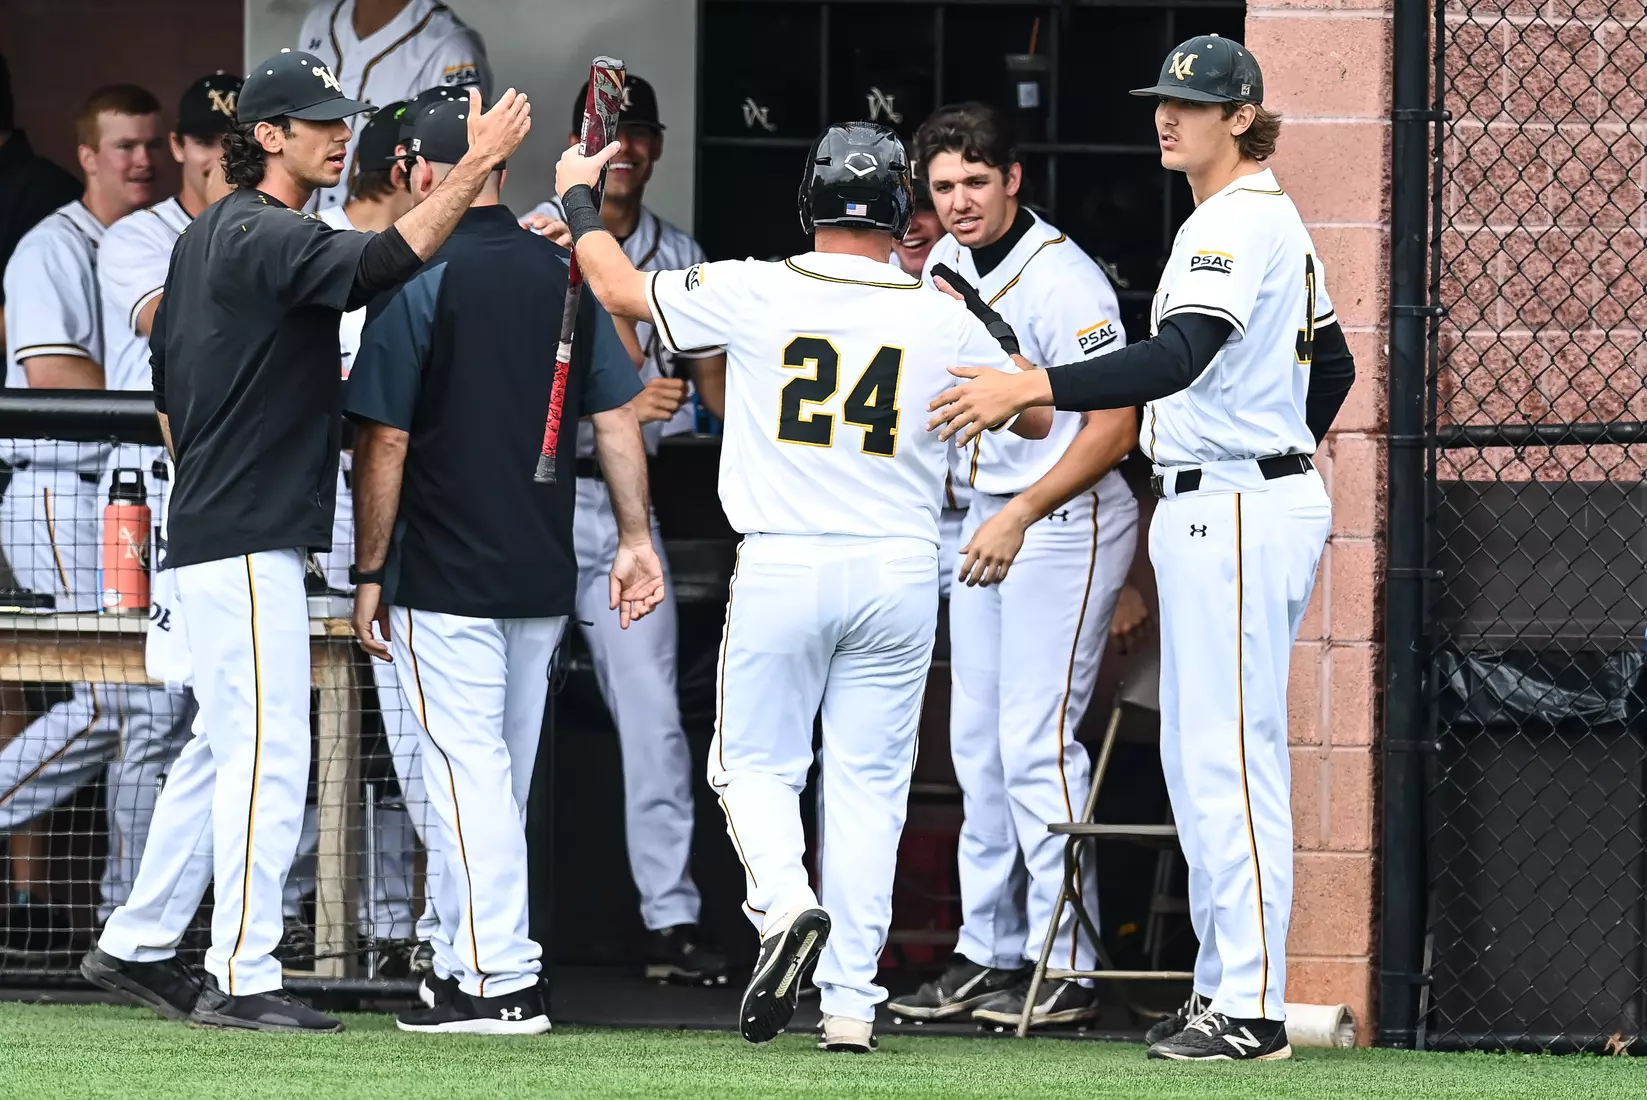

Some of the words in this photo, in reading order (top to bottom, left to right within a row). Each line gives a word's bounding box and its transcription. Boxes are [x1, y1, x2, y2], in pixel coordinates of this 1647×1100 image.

[445, 69, 480, 84] PSA
[1190, 255, 1234, 271] PSAC
[1078, 323, 1117, 349] PSAC
[776, 334, 905, 458] 24
[1222, 1026, 1262, 1055] N
